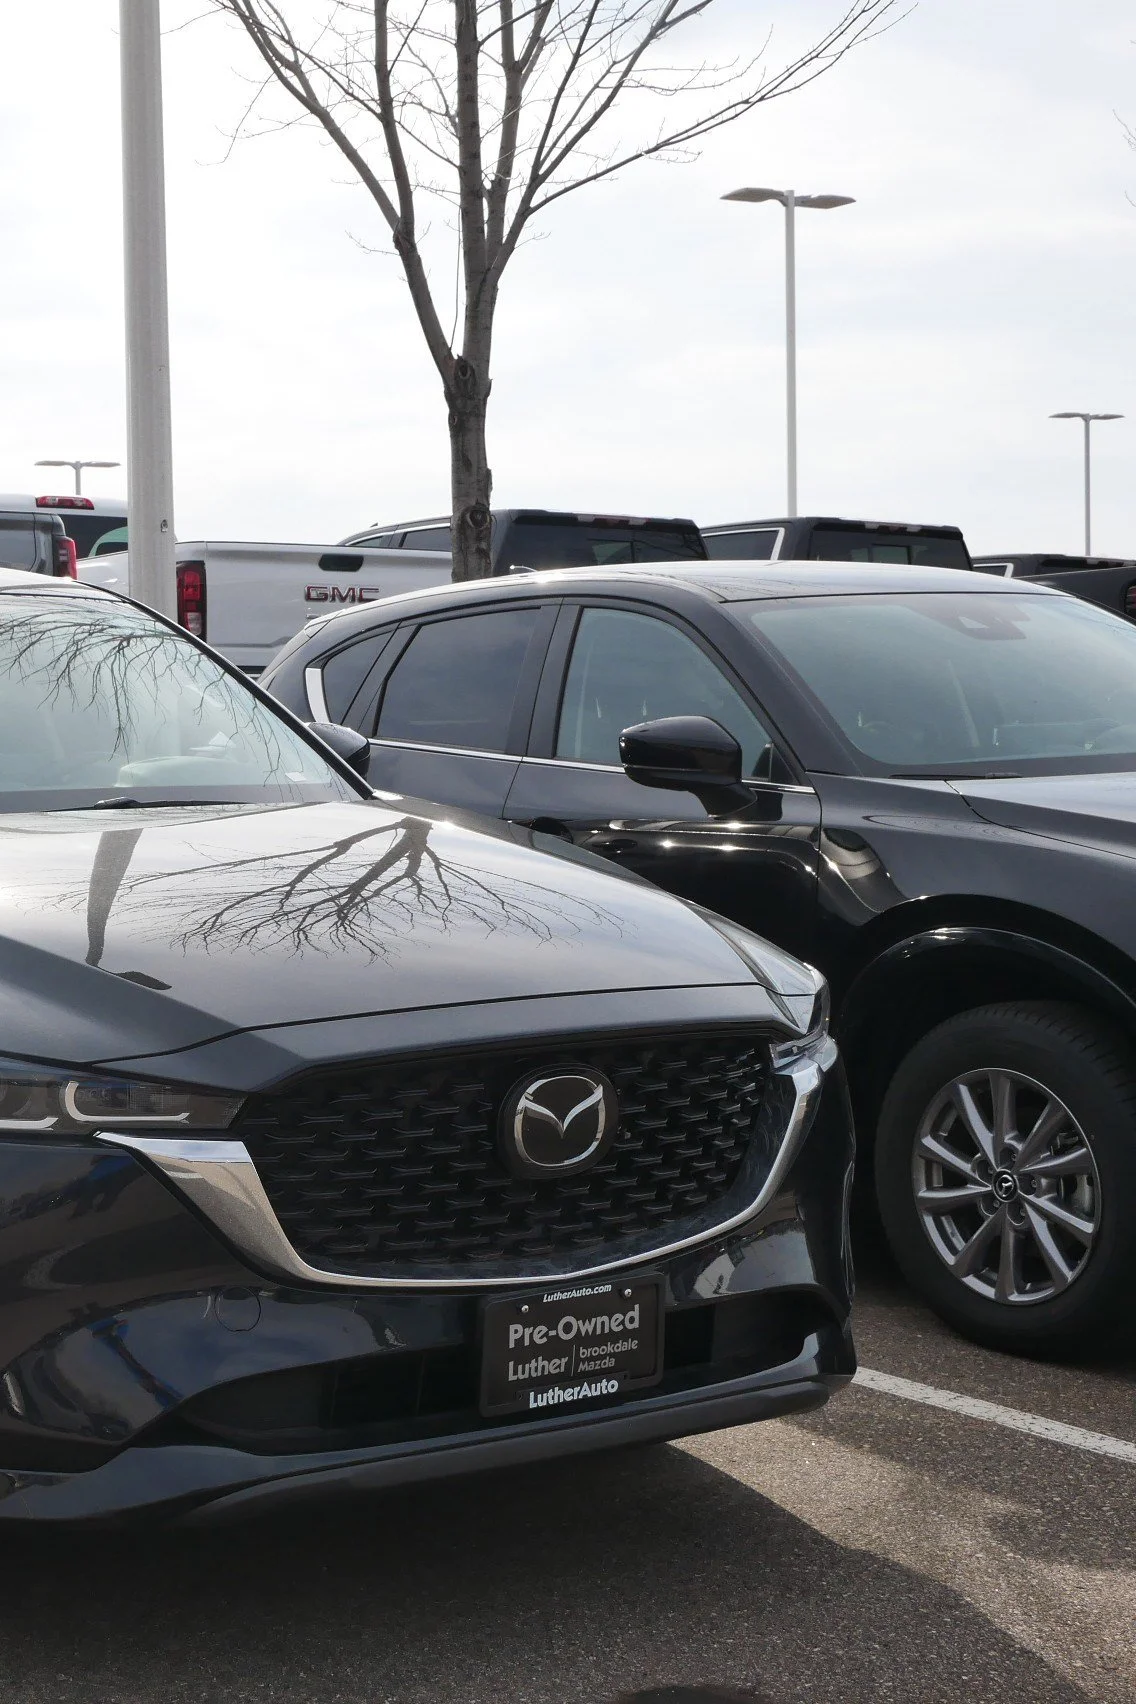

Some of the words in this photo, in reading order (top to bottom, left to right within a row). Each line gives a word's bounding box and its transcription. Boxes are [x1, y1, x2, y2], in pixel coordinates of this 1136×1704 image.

[305, 585, 379, 603] GMC
[542, 1284, 612, 1302] LutherAuto.com
[508, 1304, 640, 1348] Pre-Owned
[579, 1338, 639, 1359] brookdale
[508, 1355, 568, 1382] Luther
[578, 1357, 616, 1373] Mazda
[529, 1378, 619, 1409] LutherAuto
